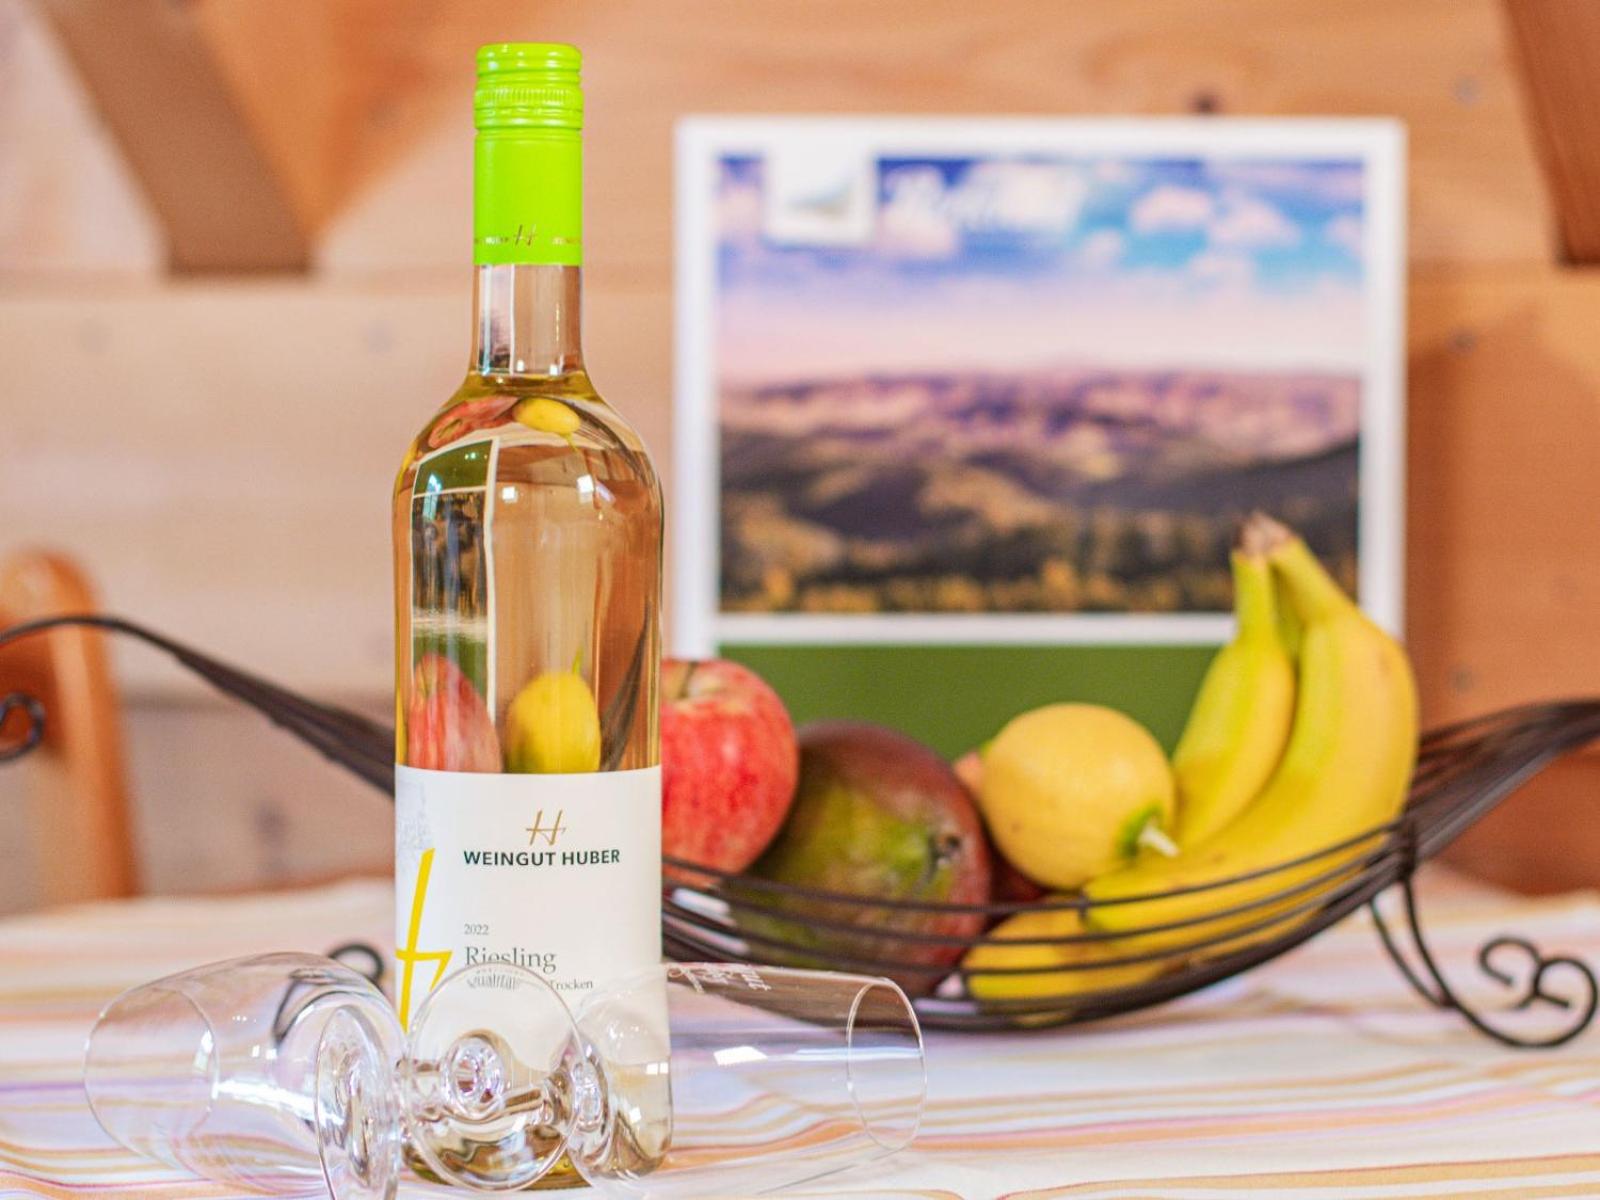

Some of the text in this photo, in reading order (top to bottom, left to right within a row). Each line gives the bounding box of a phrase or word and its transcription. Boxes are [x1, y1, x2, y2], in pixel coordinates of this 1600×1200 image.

[464, 849, 620, 866] WEINGUT HUBER
[464, 924, 490, 935] 2022
[465, 946, 557, 974] Riesling
